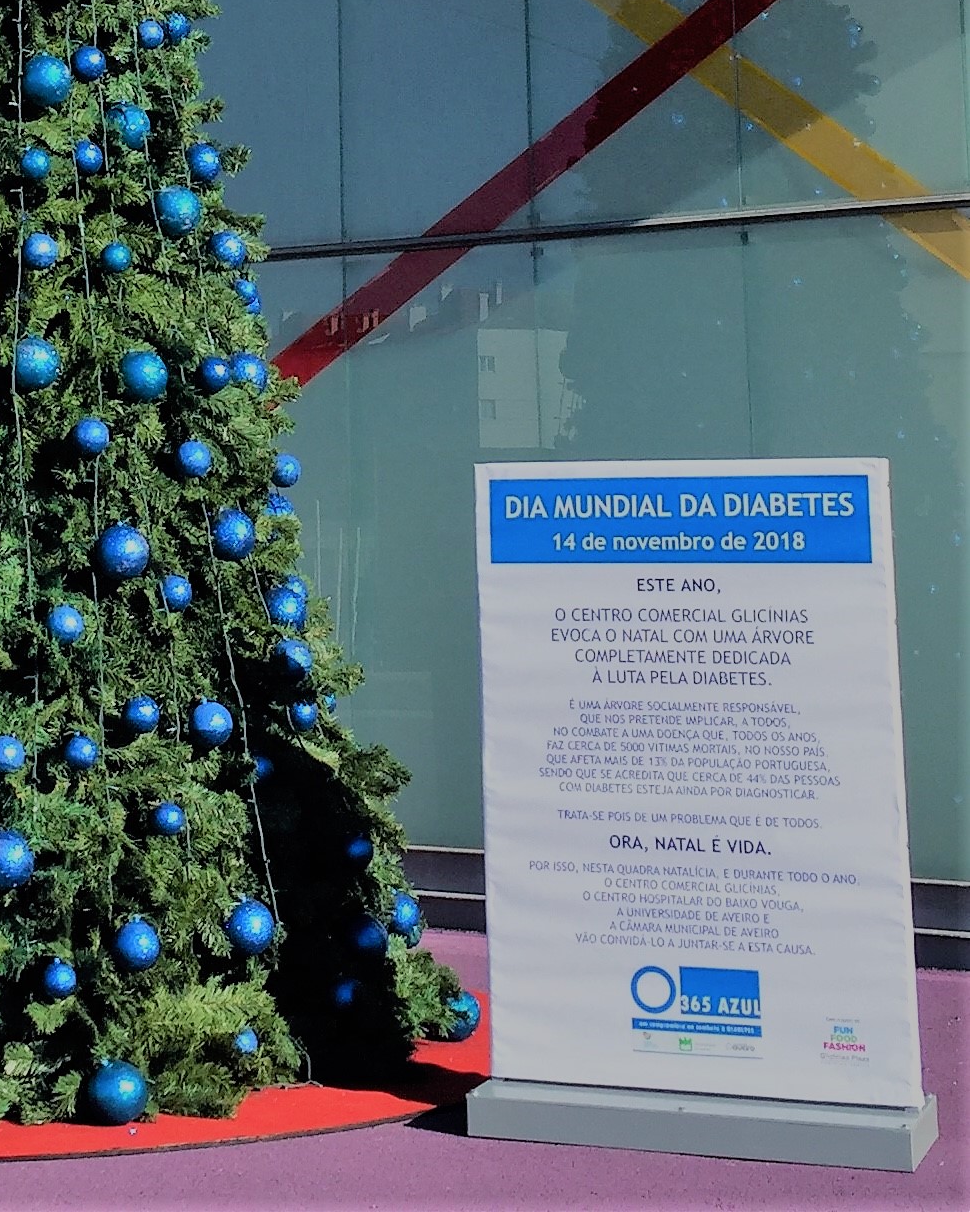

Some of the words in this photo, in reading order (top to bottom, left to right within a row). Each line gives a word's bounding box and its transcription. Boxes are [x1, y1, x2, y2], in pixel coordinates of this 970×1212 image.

[505, 495, 549, 519] DIA
[554, 494, 672, 519] MUNDIAL
[680, 494, 717, 518] DA
[724, 492, 855, 517] DIABETES
[552, 532, 576, 551] 14
[582, 532, 606, 551] de
[613, 531, 715, 551] novembro
[720, 532, 746, 550] de
[753, 531, 806, 550] 2018
[637, 578, 675, 592] ESTE
[681, 578, 721, 594] ANO,
[555, 608, 566, 622] O
[571, 608, 632, 623] CENTRO
[638, 608, 726, 623] COMERCIAL
[731, 605, 808, 624] GLICÍNIAS
[551, 628, 600, 643] EVOCA
[605, 628, 617, 643] O
[622, 629, 669, 643] NATAL
[673, 629, 708, 643] COM
[713, 630, 747, 644] UMA
[752, 626, 815, 645] ÁRVORE
[575, 649, 706, 664] COMPLETAMENTE
[712, 650, 791, 665] DEDICADA
[592, 666, 602, 684] À
[608, 670, 646, 684] LUTA
[651, 671, 688, 685] PELA
[693, 671, 772, 686] DIABETES.
[569, 698, 575, 709] É
[578, 700, 601, 709] UMA
[647, 701, 719, 712] SOCIALMENTE
[723, 701, 801, 715] RESPONSÁVEL,
[580, 713, 601, 724] QUE
[604, 714, 625, 724] NOS
[629, 715, 682, 725] PRETENDE
[686, 716, 738, 727] IMPLICAR,
[742, 717, 748, 726] A
[751, 717, 791, 729] TODOS,
[553, 726, 568, 737] NO
[571, 727, 619, 738] COMBATE
[621, 728, 629, 738] A
[631, 729, 654, 738] UMA
[657, 729, 699, 741] DOENÇA
[732, 730, 768, 741] TODOS
[771, 731, 785, 742] OS
[788, 732, 820, 744] ANOS,
[547, 740, 564, 750] FAZ
[567, 741, 601, 751] CERCA
[604, 741, 617, 751] DE
[620, 742, 645, 752] 5000
[745, 745, 761, 755] NO
[764, 746, 800, 756] NOSSO
[546, 753, 567, 765] QUE
[570, 754, 601, 765] AFETA
[604, 755, 628, 766] MAIS
[631, 756, 644, 766] DE
[671, 757, 685, 767] DA
[688, 757, 751, 771] POPULAÇÃO
[755, 759, 831, 773] PORTUGUESA,
[539, 767, 573, 778] SENDO
[575, 768, 597, 780] QUE
[600, 769, 612, 779] SE
[615, 769, 665, 781] ACREDITA
[667, 771, 689, 782] QUE
[692, 772, 727, 783] CERCA
[730, 773, 743, 784] DE
[770, 774, 790, 785] DAS
[794, 775, 841, 787] PESSOAS
[559, 782, 582, 792] COM
[585, 783, 633, 794] DIABETES
[636, 784, 673, 795] ESTEJA
[676, 785, 708, 796] AINDA
[711, 787, 732, 797] POR
[557, 809, 605, 821] TRATA-SE
[608, 811, 631, 822] POIS
[634, 812, 648, 822] DE
[651, 813, 667, 823] UM
[670, 813, 727, 825] PROBLEMA
[730, 815, 751, 828] QUE
[765, 816, 779, 828] DE
[609, 834, 649, 853] ORA,
[655, 836, 706, 853] NATAL
[712, 835, 721, 853] É
[727, 839, 772, 855] VIDA.
[529, 860, 550, 871] POR
[553, 861, 579, 873] ISSO,
[582, 862, 614, 874] NESTA
[617, 864, 660, 875] QUADRA
[723, 869, 730, 879] E
[733, 869, 783, 881] DURANTE
[787, 871, 818, 883] TODO
[821, 873, 830, 883] O
[604, 877, 613, 888] O
[615, 878, 658, 890] CENTRO
[661, 880, 721, 893] COMERCIAL
[582, 890, 591, 901] O
[594, 892, 636, 904] CENTRO
[639, 894, 703, 906] HOSPITALAR
[707, 897, 722, 907] DO
[725, 897, 758, 909] BAIXO
[761, 899, 804, 913] VOUGA,
[616, 907, 624, 917] A
[626, 907, 701, 921] UNIVERSIDADE
[705, 911, 719, 922] DE
[721, 912, 760, 924] AVEIRO
[763, 913, 770, 924] E
[609, 921, 617, 931] A
[665, 923, 720, 936] MUNICIPAL
[724, 926, 737, 937] DE
[740, 927, 779, 939] AVEIRO
[575, 931, 597, 944] VÃO
[667, 938, 675, 948] A
[677, 938, 735, 952] JUNTAR-SE
[738, 941, 746, 952] A
[748, 942, 774, 953] ESTA
[680, 994, 711, 1013] 365
[717, 996, 761, 1016] AZUL
